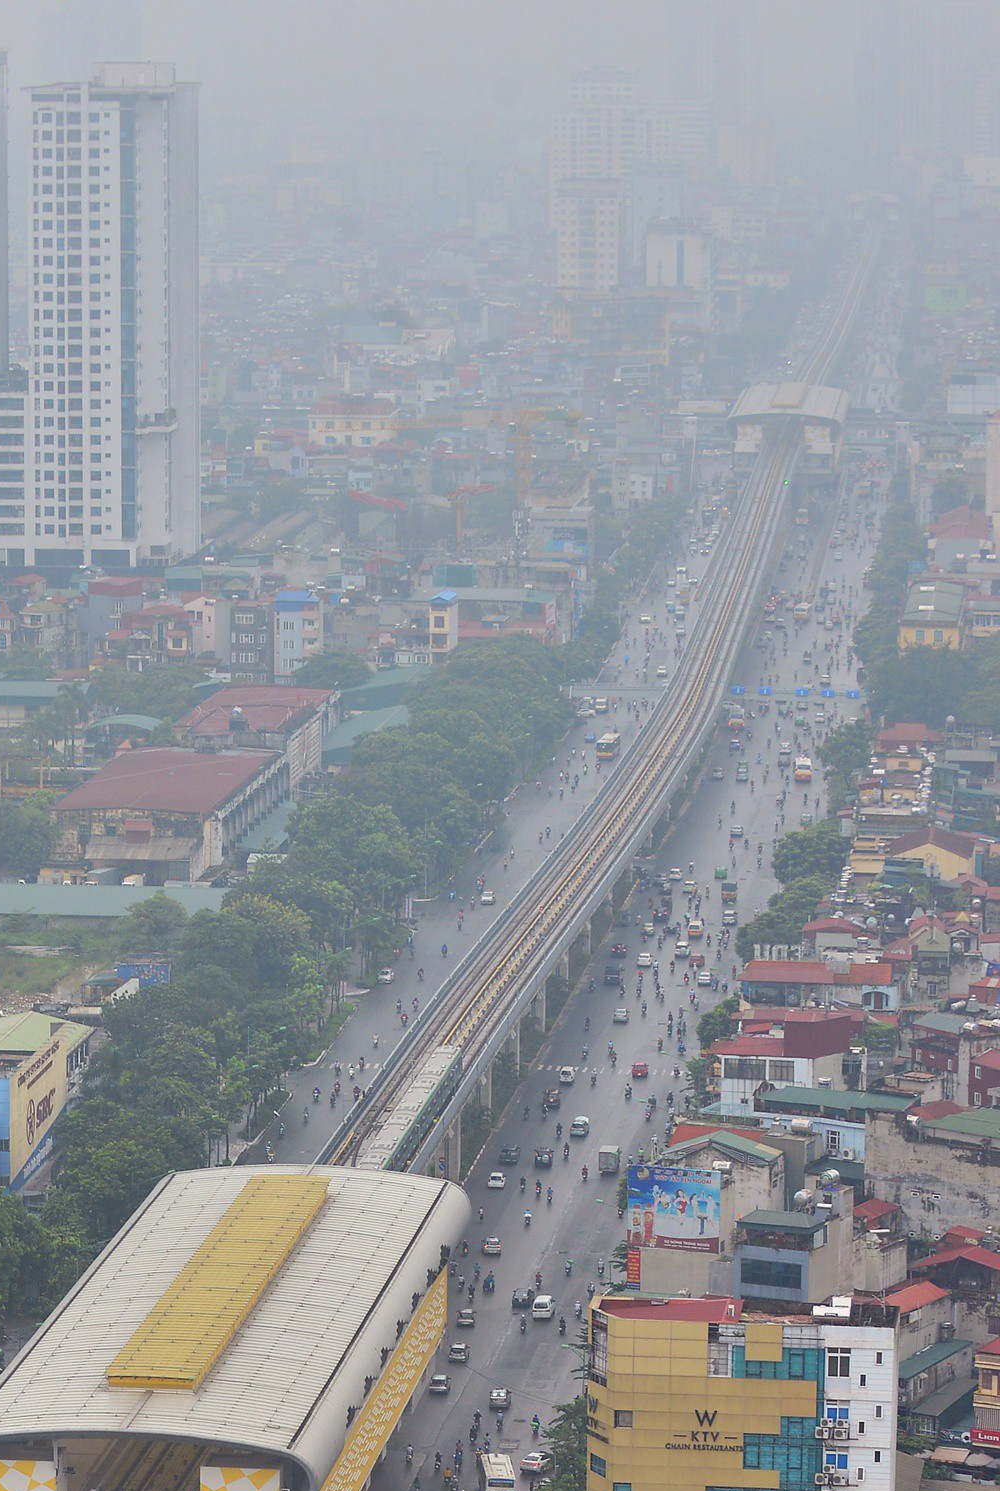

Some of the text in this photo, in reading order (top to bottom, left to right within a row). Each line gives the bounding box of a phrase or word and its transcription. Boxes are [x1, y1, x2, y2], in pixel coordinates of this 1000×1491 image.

[694, 1409, 718, 1427] W
[691, 1431, 720, 1442] KTV
[693, 1444, 743, 1452] RESTAURANTS
